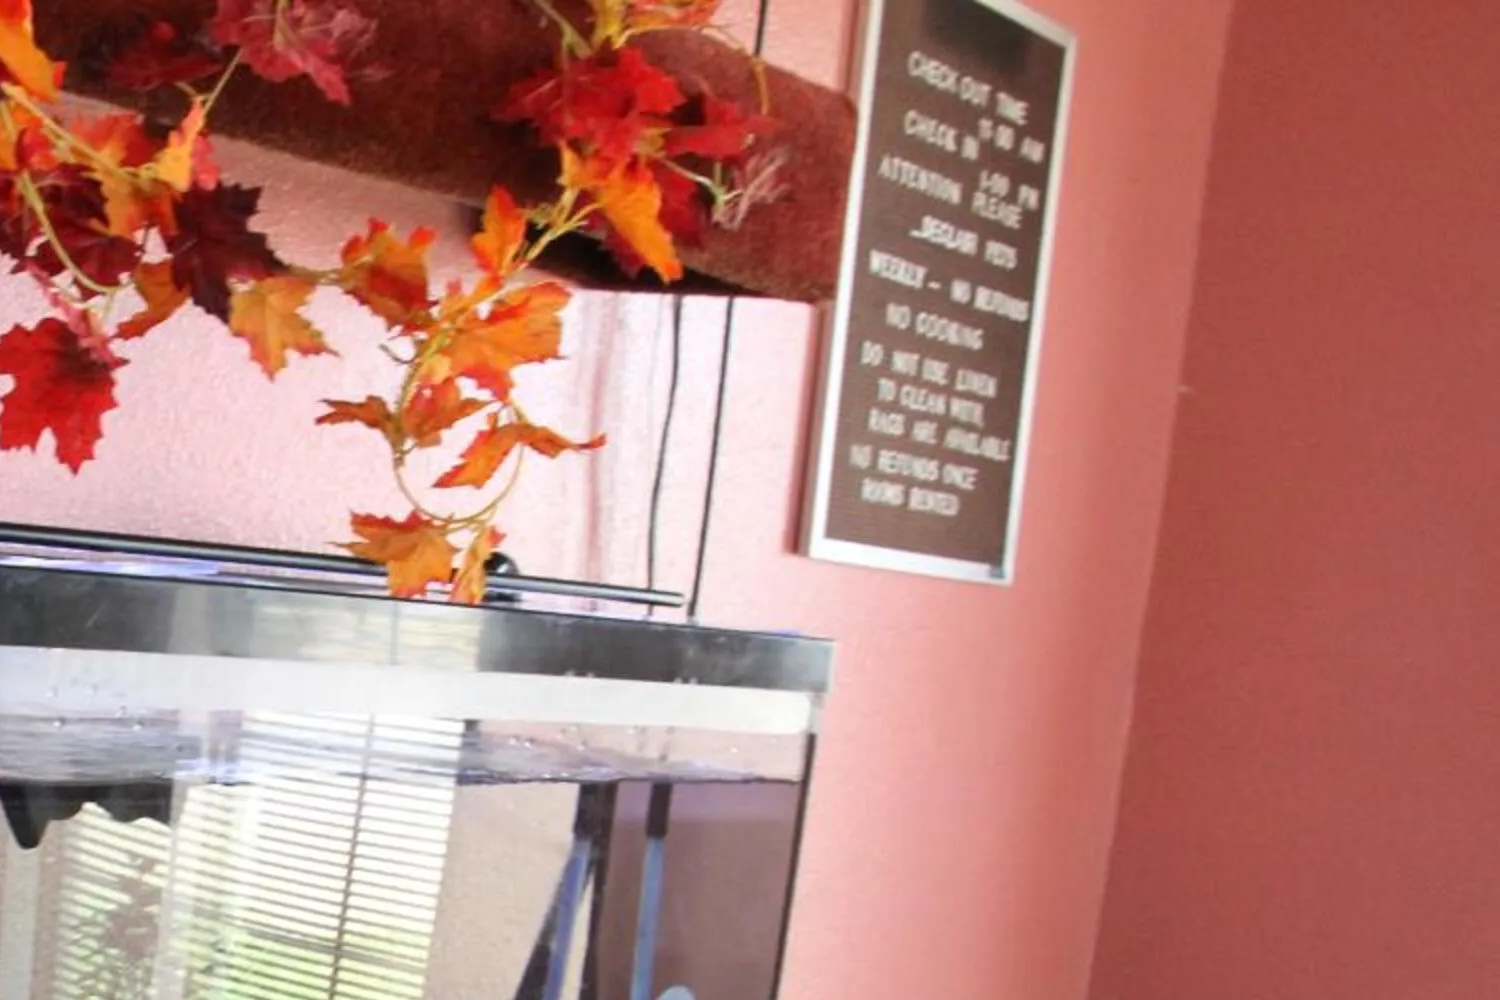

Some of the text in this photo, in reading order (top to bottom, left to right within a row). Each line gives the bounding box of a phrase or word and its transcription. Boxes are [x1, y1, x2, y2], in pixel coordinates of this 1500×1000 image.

[908, 50, 959, 93] CHECK
[904, 110, 957, 153] CHECK
[878, 152, 1022, 229] ATTENTION PLEASE
[915, 311, 984, 350] COOKING
[899, 383, 947, 416] CLEAN
